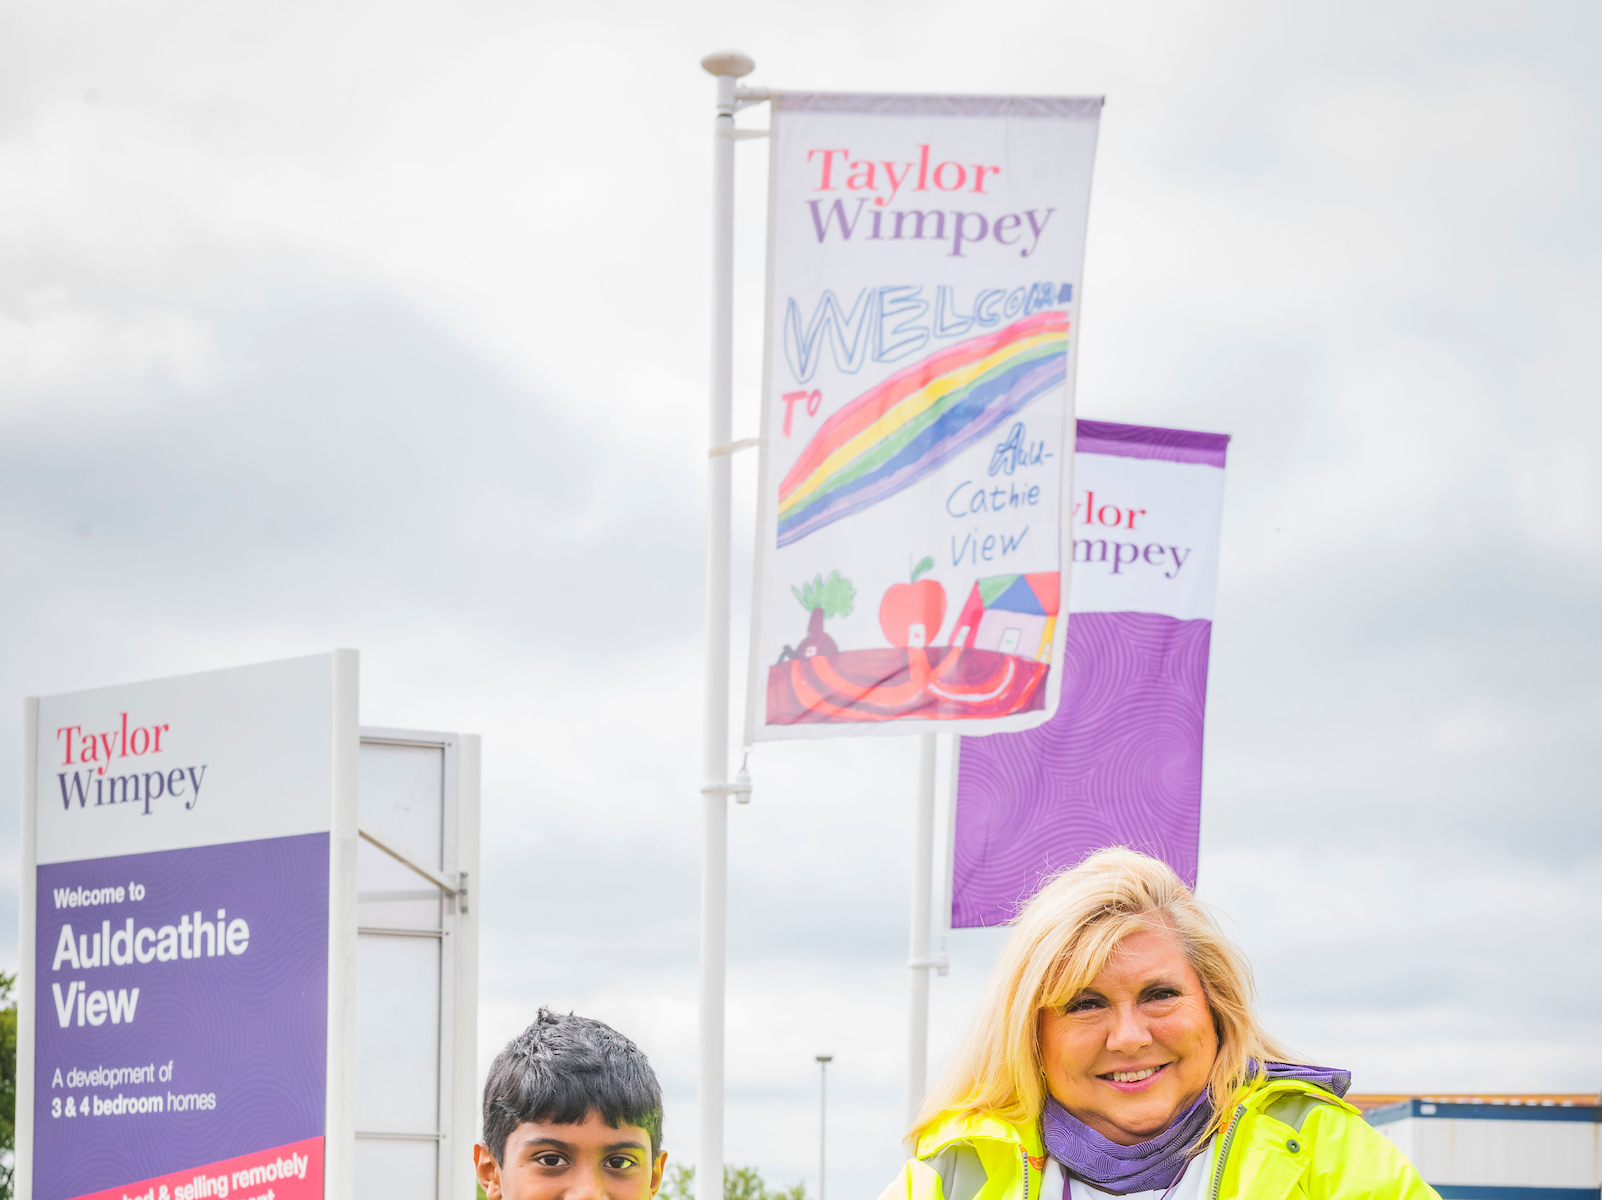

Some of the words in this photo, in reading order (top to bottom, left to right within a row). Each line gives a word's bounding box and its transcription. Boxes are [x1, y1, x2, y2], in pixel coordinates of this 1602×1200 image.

[807, 144, 1000, 207] Taylor
[805, 197, 1057, 258] Wimpey
[946, 480, 1040, 518] Cathie
[57, 712, 169, 775] Taylor
[57, 765, 207, 816] Wimpey
[53, 886, 125, 909] Welcome
[128, 881, 145, 902] to
[52, 908, 250, 971] Auldcathie
[51, 980, 140, 1028] View
[52, 1067, 64, 1089] A
[66, 1062, 155, 1090] development
[158, 1060, 174, 1082] of
[51, 1097, 62, 1119] 3
[64, 1096, 77, 1117] &
[79, 1095, 90, 1116] 4
[93, 1093, 163, 1116] bedroom
[167, 1090, 217, 1112] homes
[232, 1152, 309, 1190] remotely
